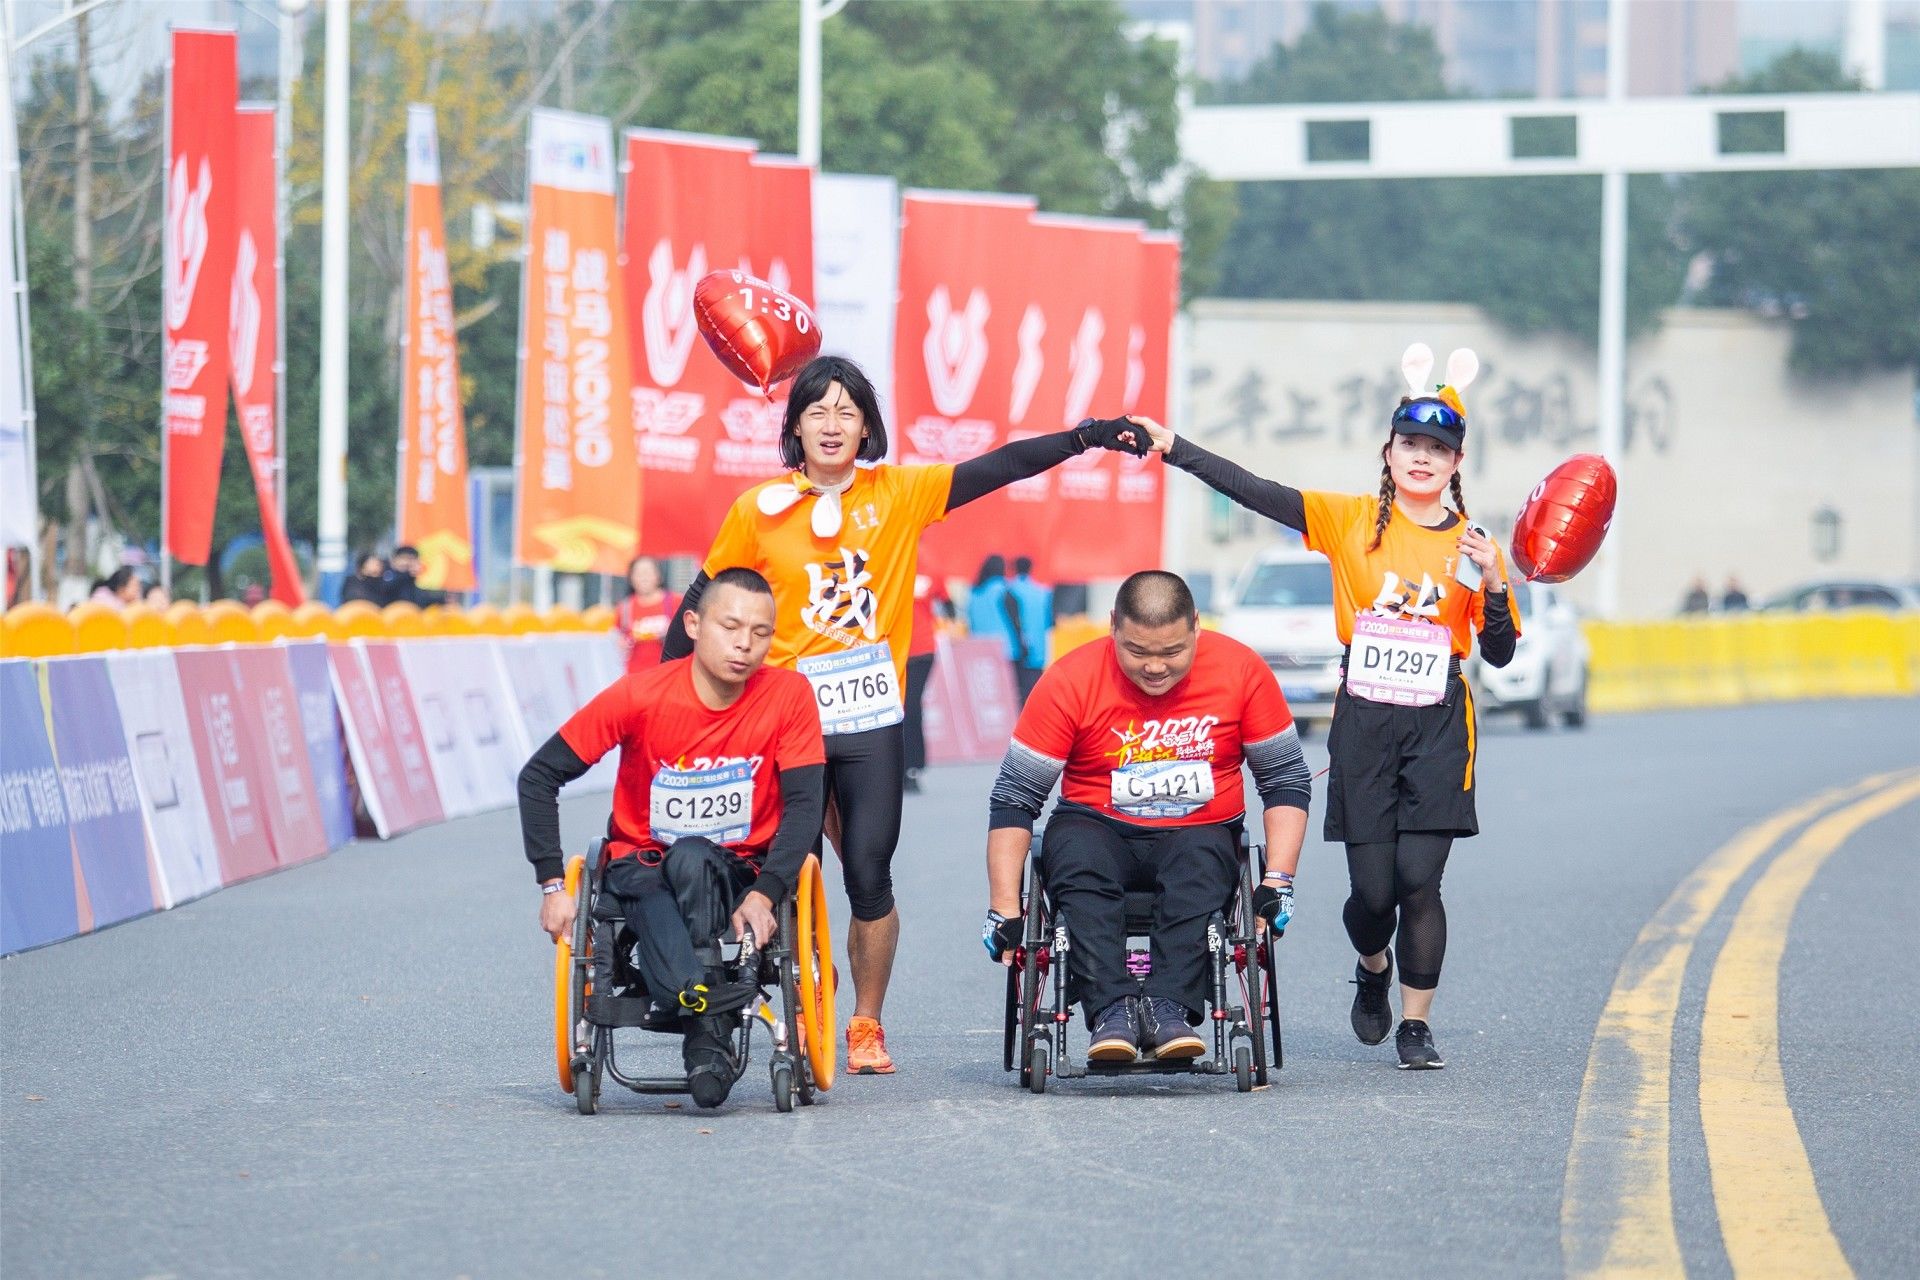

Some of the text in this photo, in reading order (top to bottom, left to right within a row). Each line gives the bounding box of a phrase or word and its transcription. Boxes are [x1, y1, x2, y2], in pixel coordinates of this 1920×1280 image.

[739, 288, 809, 334] 1:30
[800, 546, 878, 640] 战
[1363, 645, 1438, 677] D1297
[817, 672, 889, 707] C1766
[663, 774, 689, 787] 2020
[1127, 771, 1200, 798] C1121
[666, 792, 742, 819] C1239
